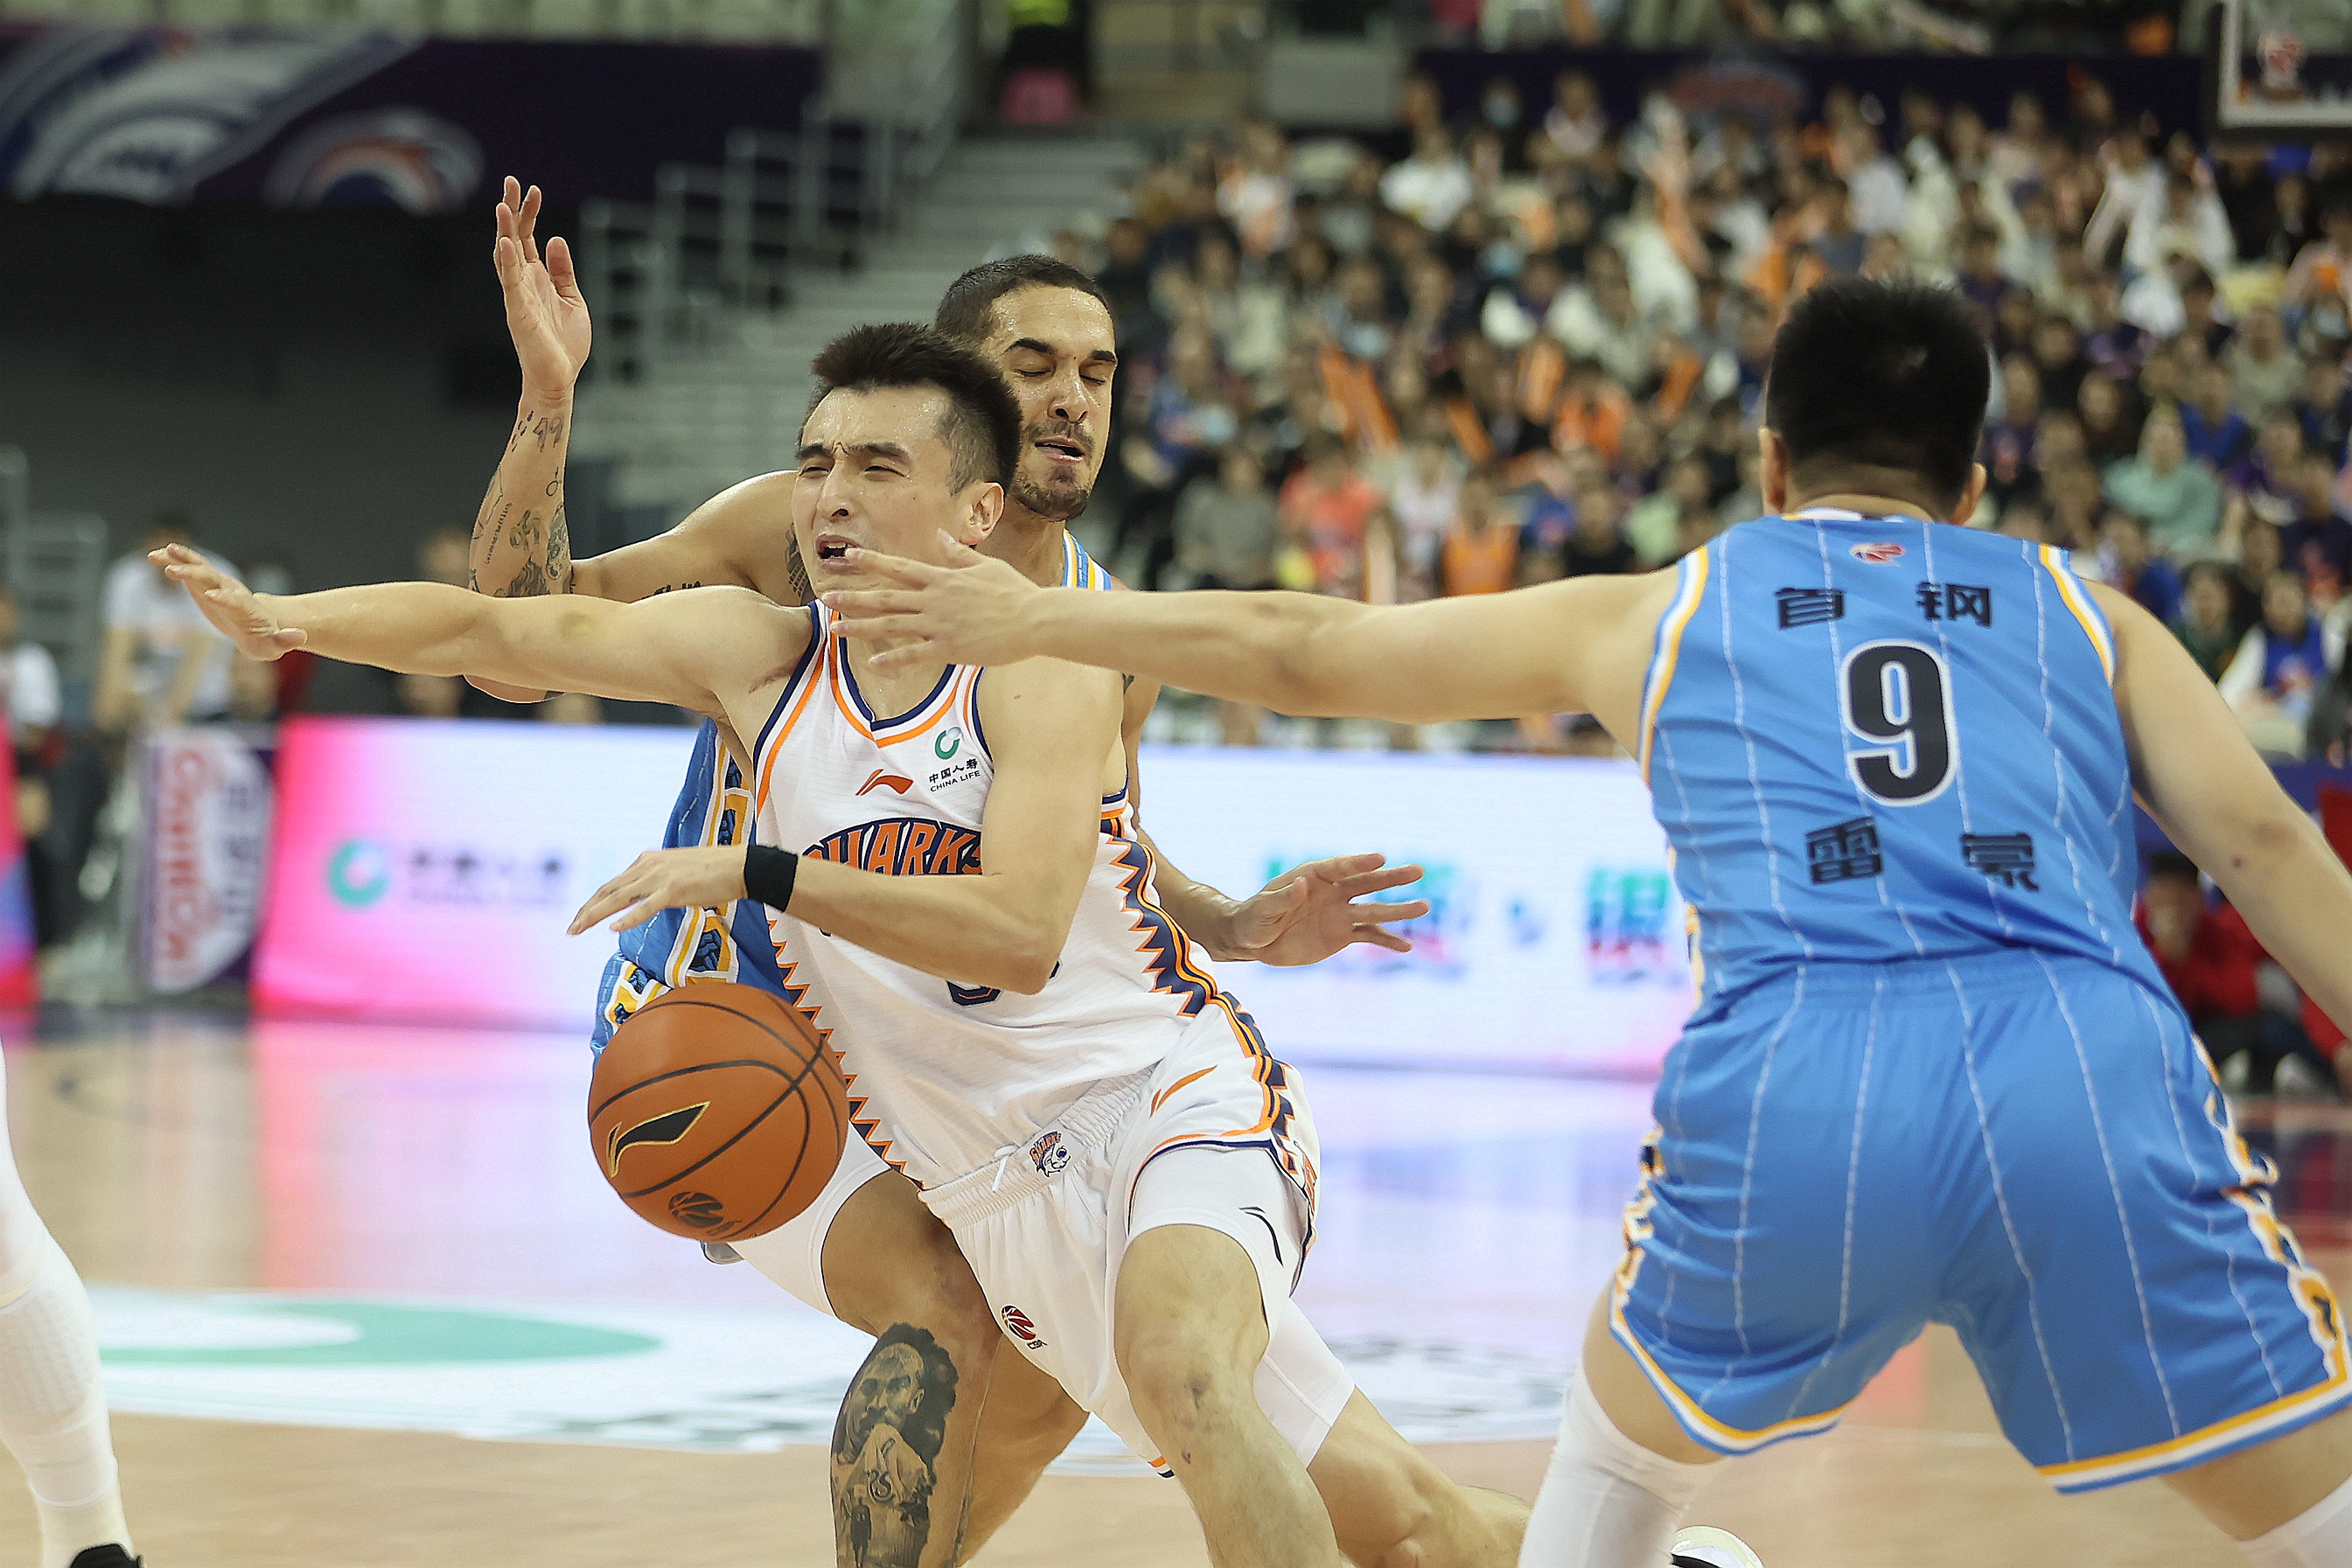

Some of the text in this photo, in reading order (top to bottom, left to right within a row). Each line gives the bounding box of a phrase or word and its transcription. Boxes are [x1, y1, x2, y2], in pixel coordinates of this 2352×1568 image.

[1840, 640, 1957, 805] 9
[929, 758, 978, 784] 中国人寿
[930, 770, 981, 792] CHINA LIFE
[802, 818, 984, 877] HARK
